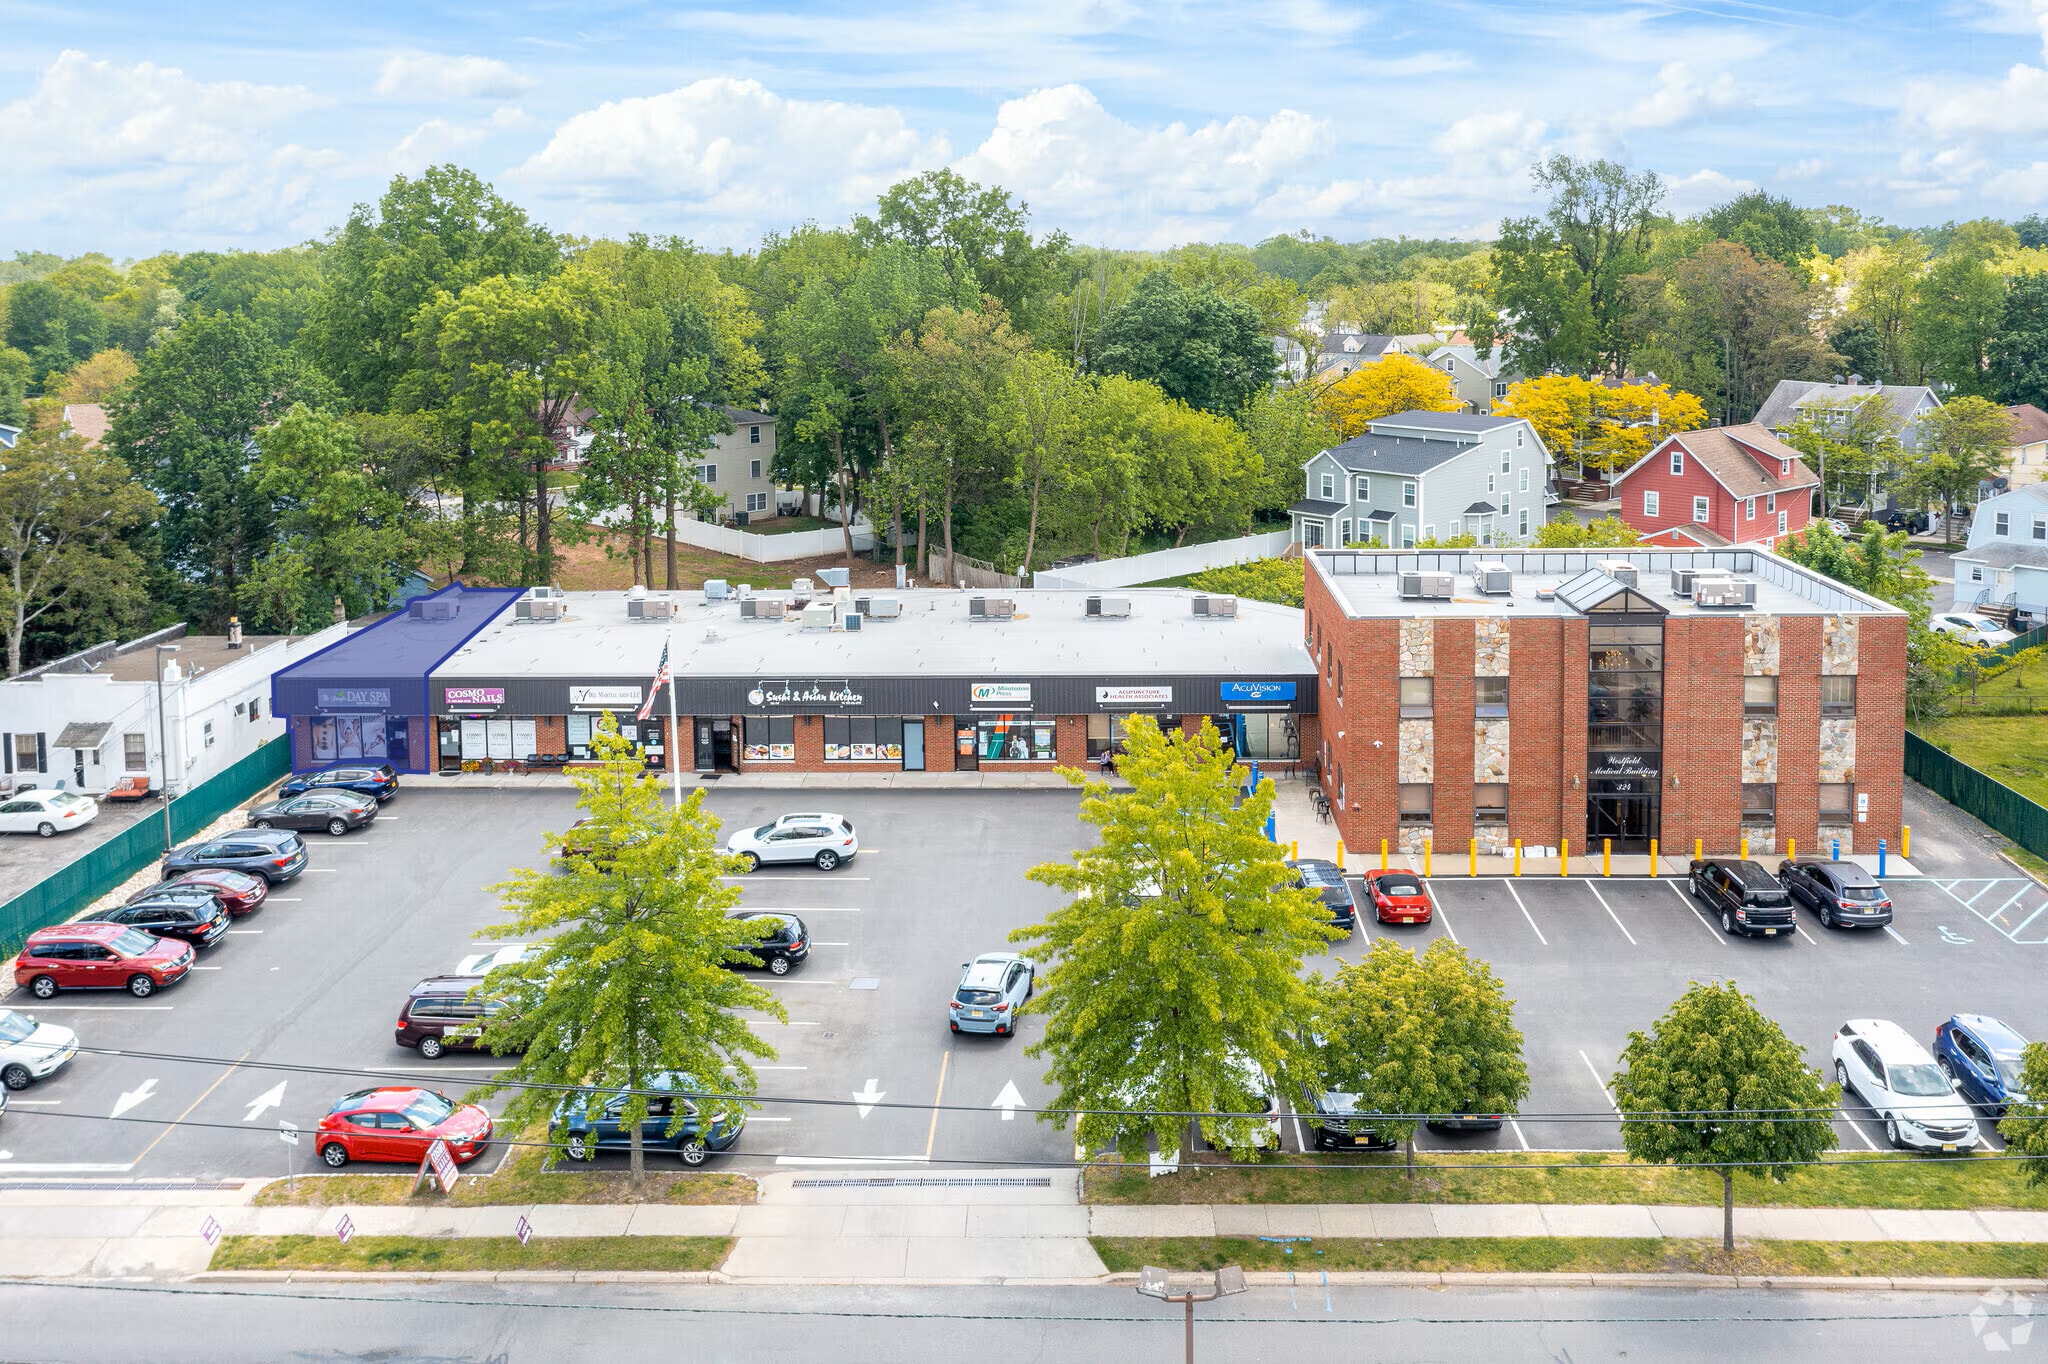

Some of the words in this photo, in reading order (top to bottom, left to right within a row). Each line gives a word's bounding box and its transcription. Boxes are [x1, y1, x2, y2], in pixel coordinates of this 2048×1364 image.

[347, 691, 368, 702] DAY
[369, 691, 388, 702] SPA
[448, 688, 485, 699] COSMO
[472, 694, 503, 703] NAILS
[766, 690, 791, 702] Sushi
[793, 690, 801, 702] &
[802, 690, 827, 702] Asian
[829, 690, 863, 702] Kitchen
[1607, 756, 1642, 770] Westfield
[1590, 766, 1623, 775] Medical
[1623, 766, 1658, 778] Building
[1616, 783, 1632, 791] 324
